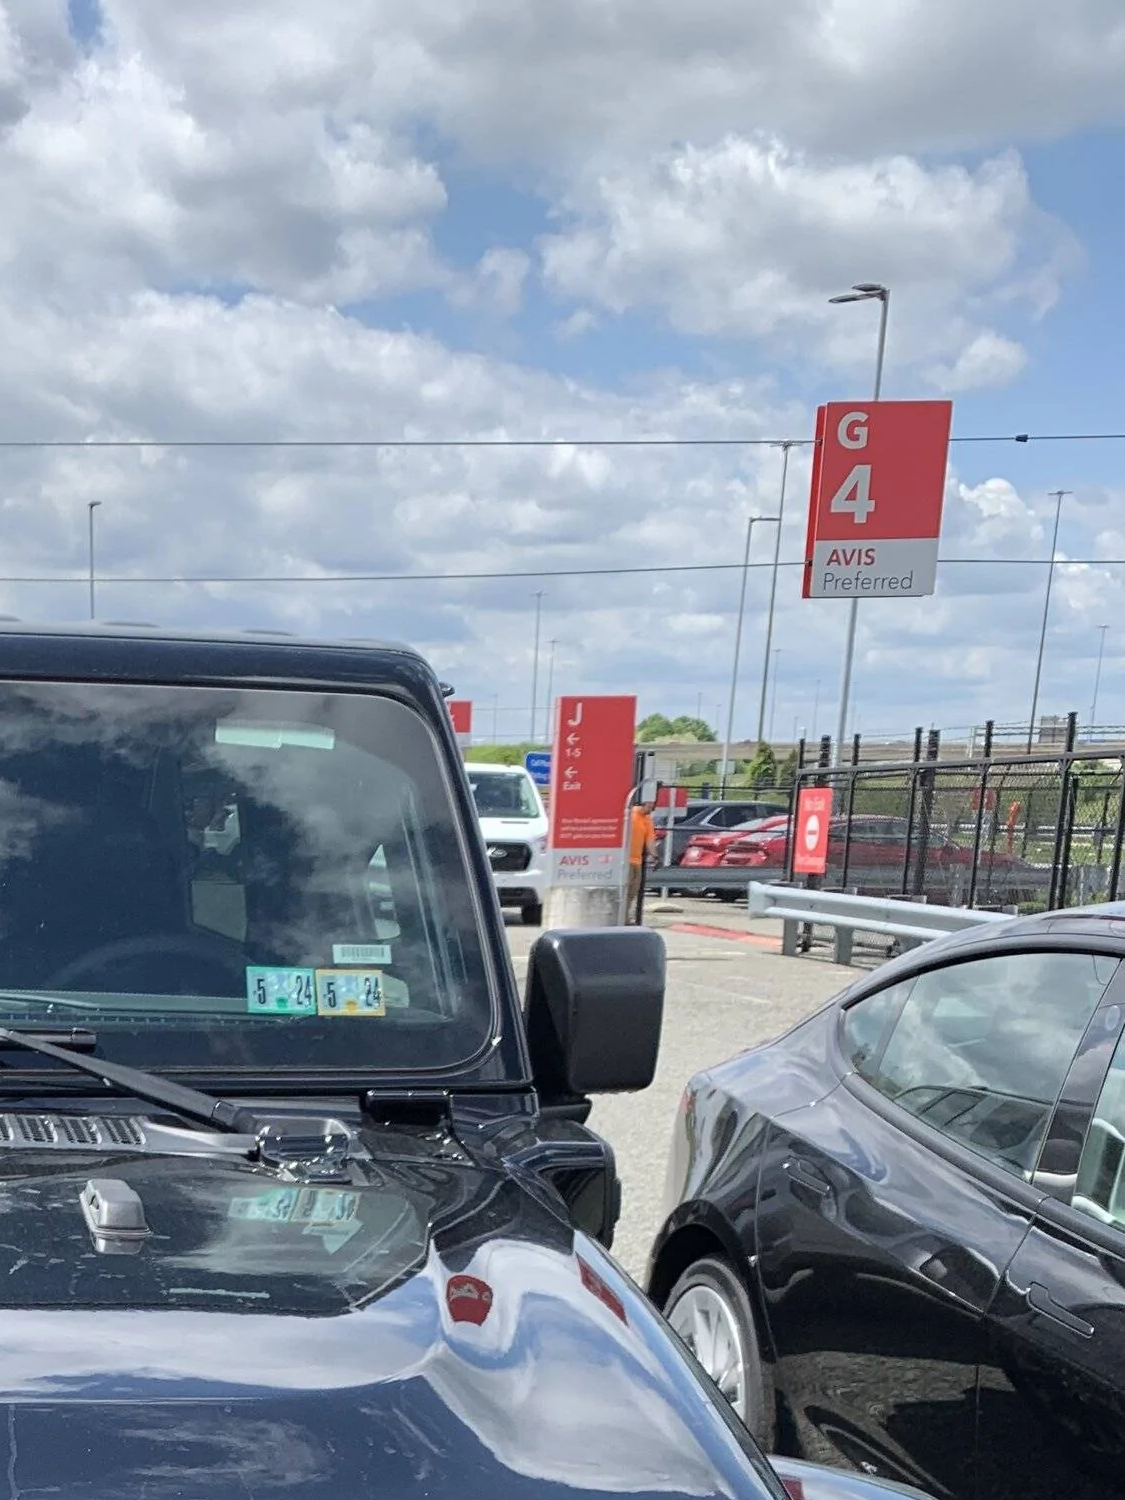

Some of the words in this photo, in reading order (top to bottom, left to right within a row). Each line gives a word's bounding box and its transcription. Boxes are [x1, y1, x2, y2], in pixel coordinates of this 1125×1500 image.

[837, 411, 869, 450] G
[830, 464, 876, 524] 4
[826, 548, 876, 567] AVIS
[823, 570, 914, 593] Preferred
[568, 702, 583, 726] J
[565, 748, 582, 758] 1-5
[563, 780, 582, 791] Exit
[559, 855, 590, 866] AVIS
[557, 868, 614, 880] Preferred
[295, 975, 312, 1007] 24
